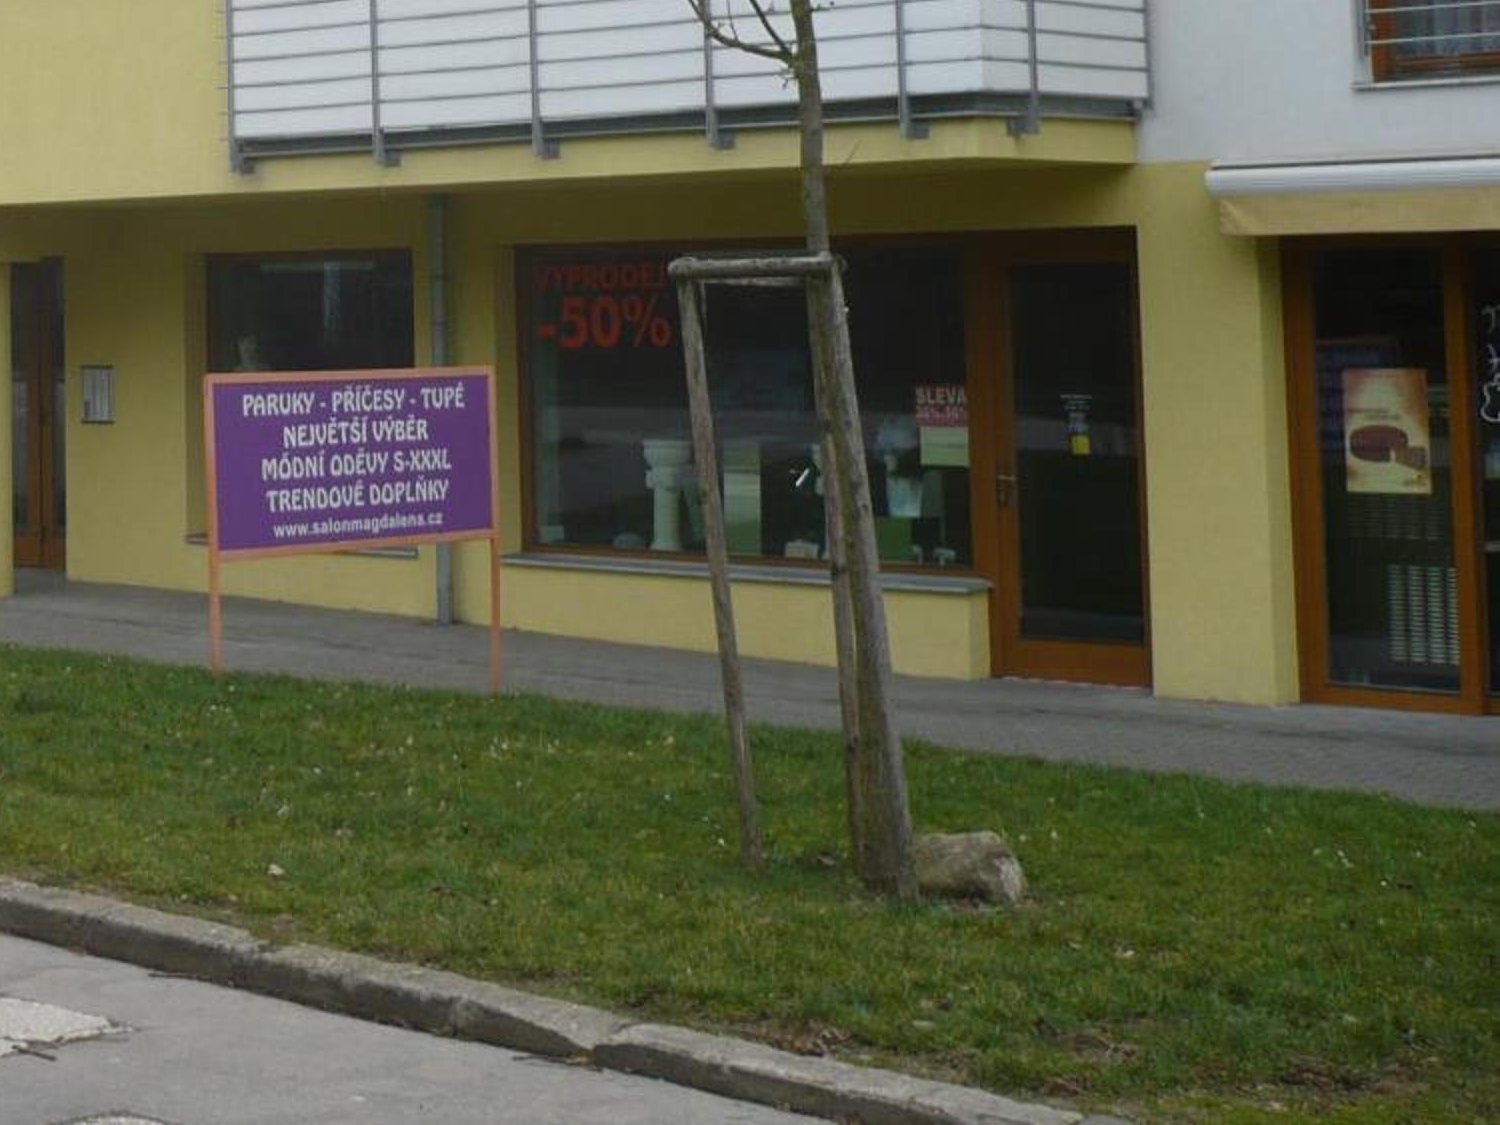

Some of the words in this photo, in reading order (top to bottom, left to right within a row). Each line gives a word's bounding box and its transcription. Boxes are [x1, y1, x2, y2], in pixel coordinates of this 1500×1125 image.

[538, 292, 672, 348] -50%
[242, 392, 315, 417] PARUKY
[331, 384, 405, 413] PŘÍČESY
[420, 382, 465, 408] TUPÉ
[283, 416, 369, 449] NEJVĚTŠÍ
[372, 414, 429, 443] VÝBĚR
[260, 451, 326, 481] MÓDNÍ
[330, 447, 389, 476] ODĚVY
[393, 448, 452, 473] S-XXXL
[265, 479, 365, 513] TRENDOVÉ
[369, 475, 449, 506] DOPLŇKY
[273, 511, 443, 539] www.salonmagdalena.cz
